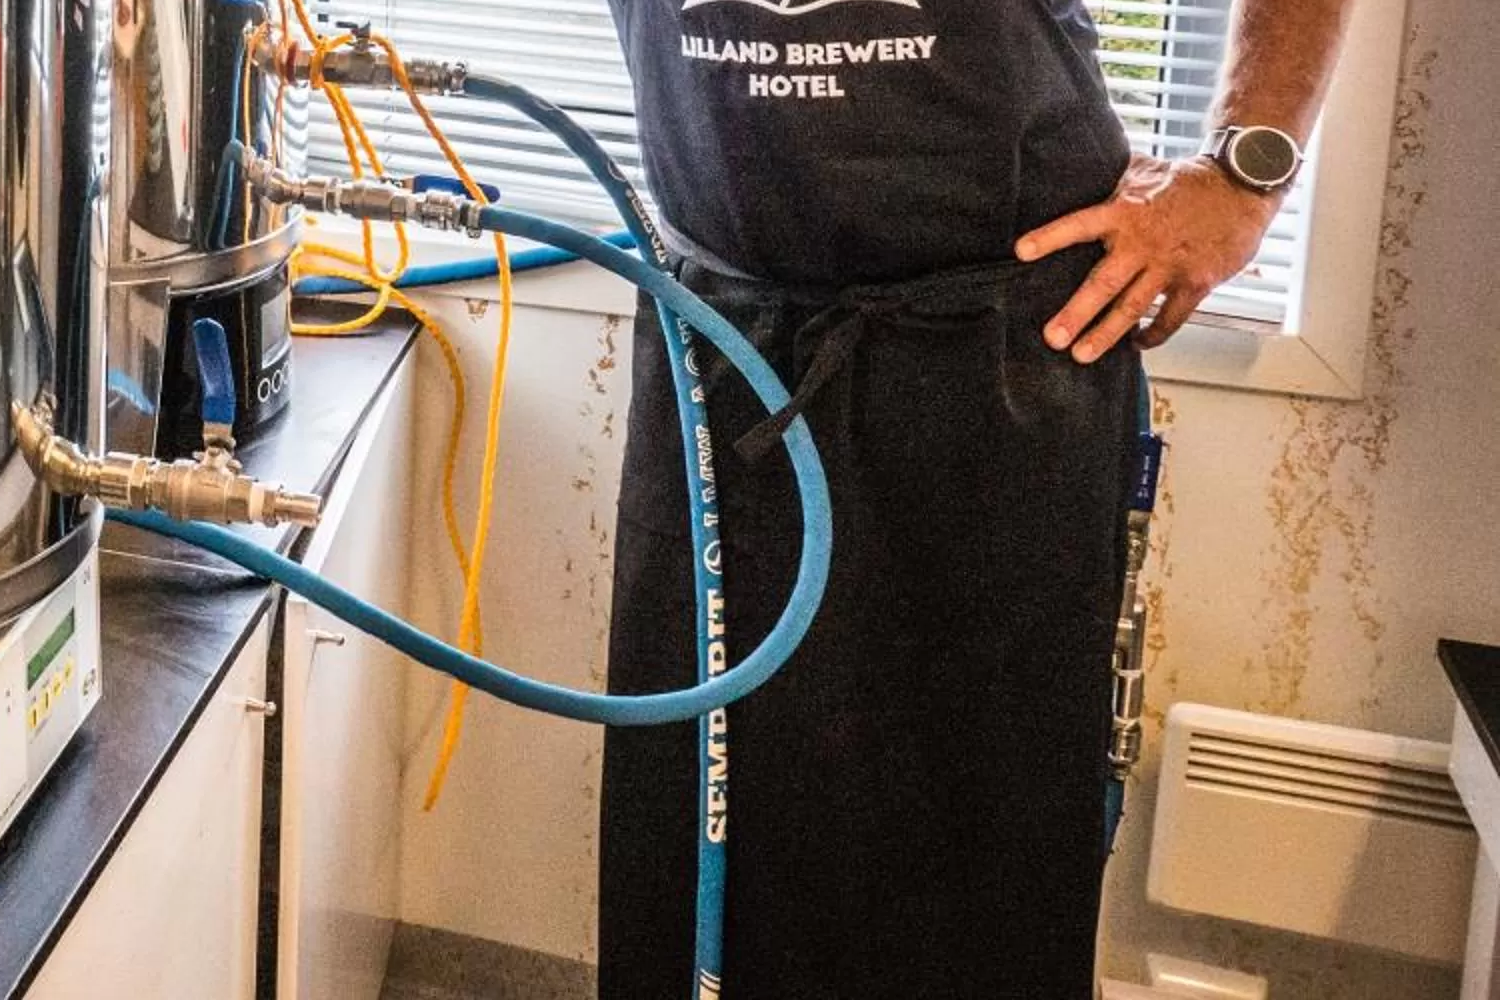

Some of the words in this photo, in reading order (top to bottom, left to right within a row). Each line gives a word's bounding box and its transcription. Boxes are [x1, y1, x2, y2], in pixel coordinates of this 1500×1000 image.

[681, 34, 779, 65] LILLAND
[785, 35, 937, 66] BREWERY
[749, 74, 845, 98] HOTEL
[707, 589, 727, 844] SEMPRIT
